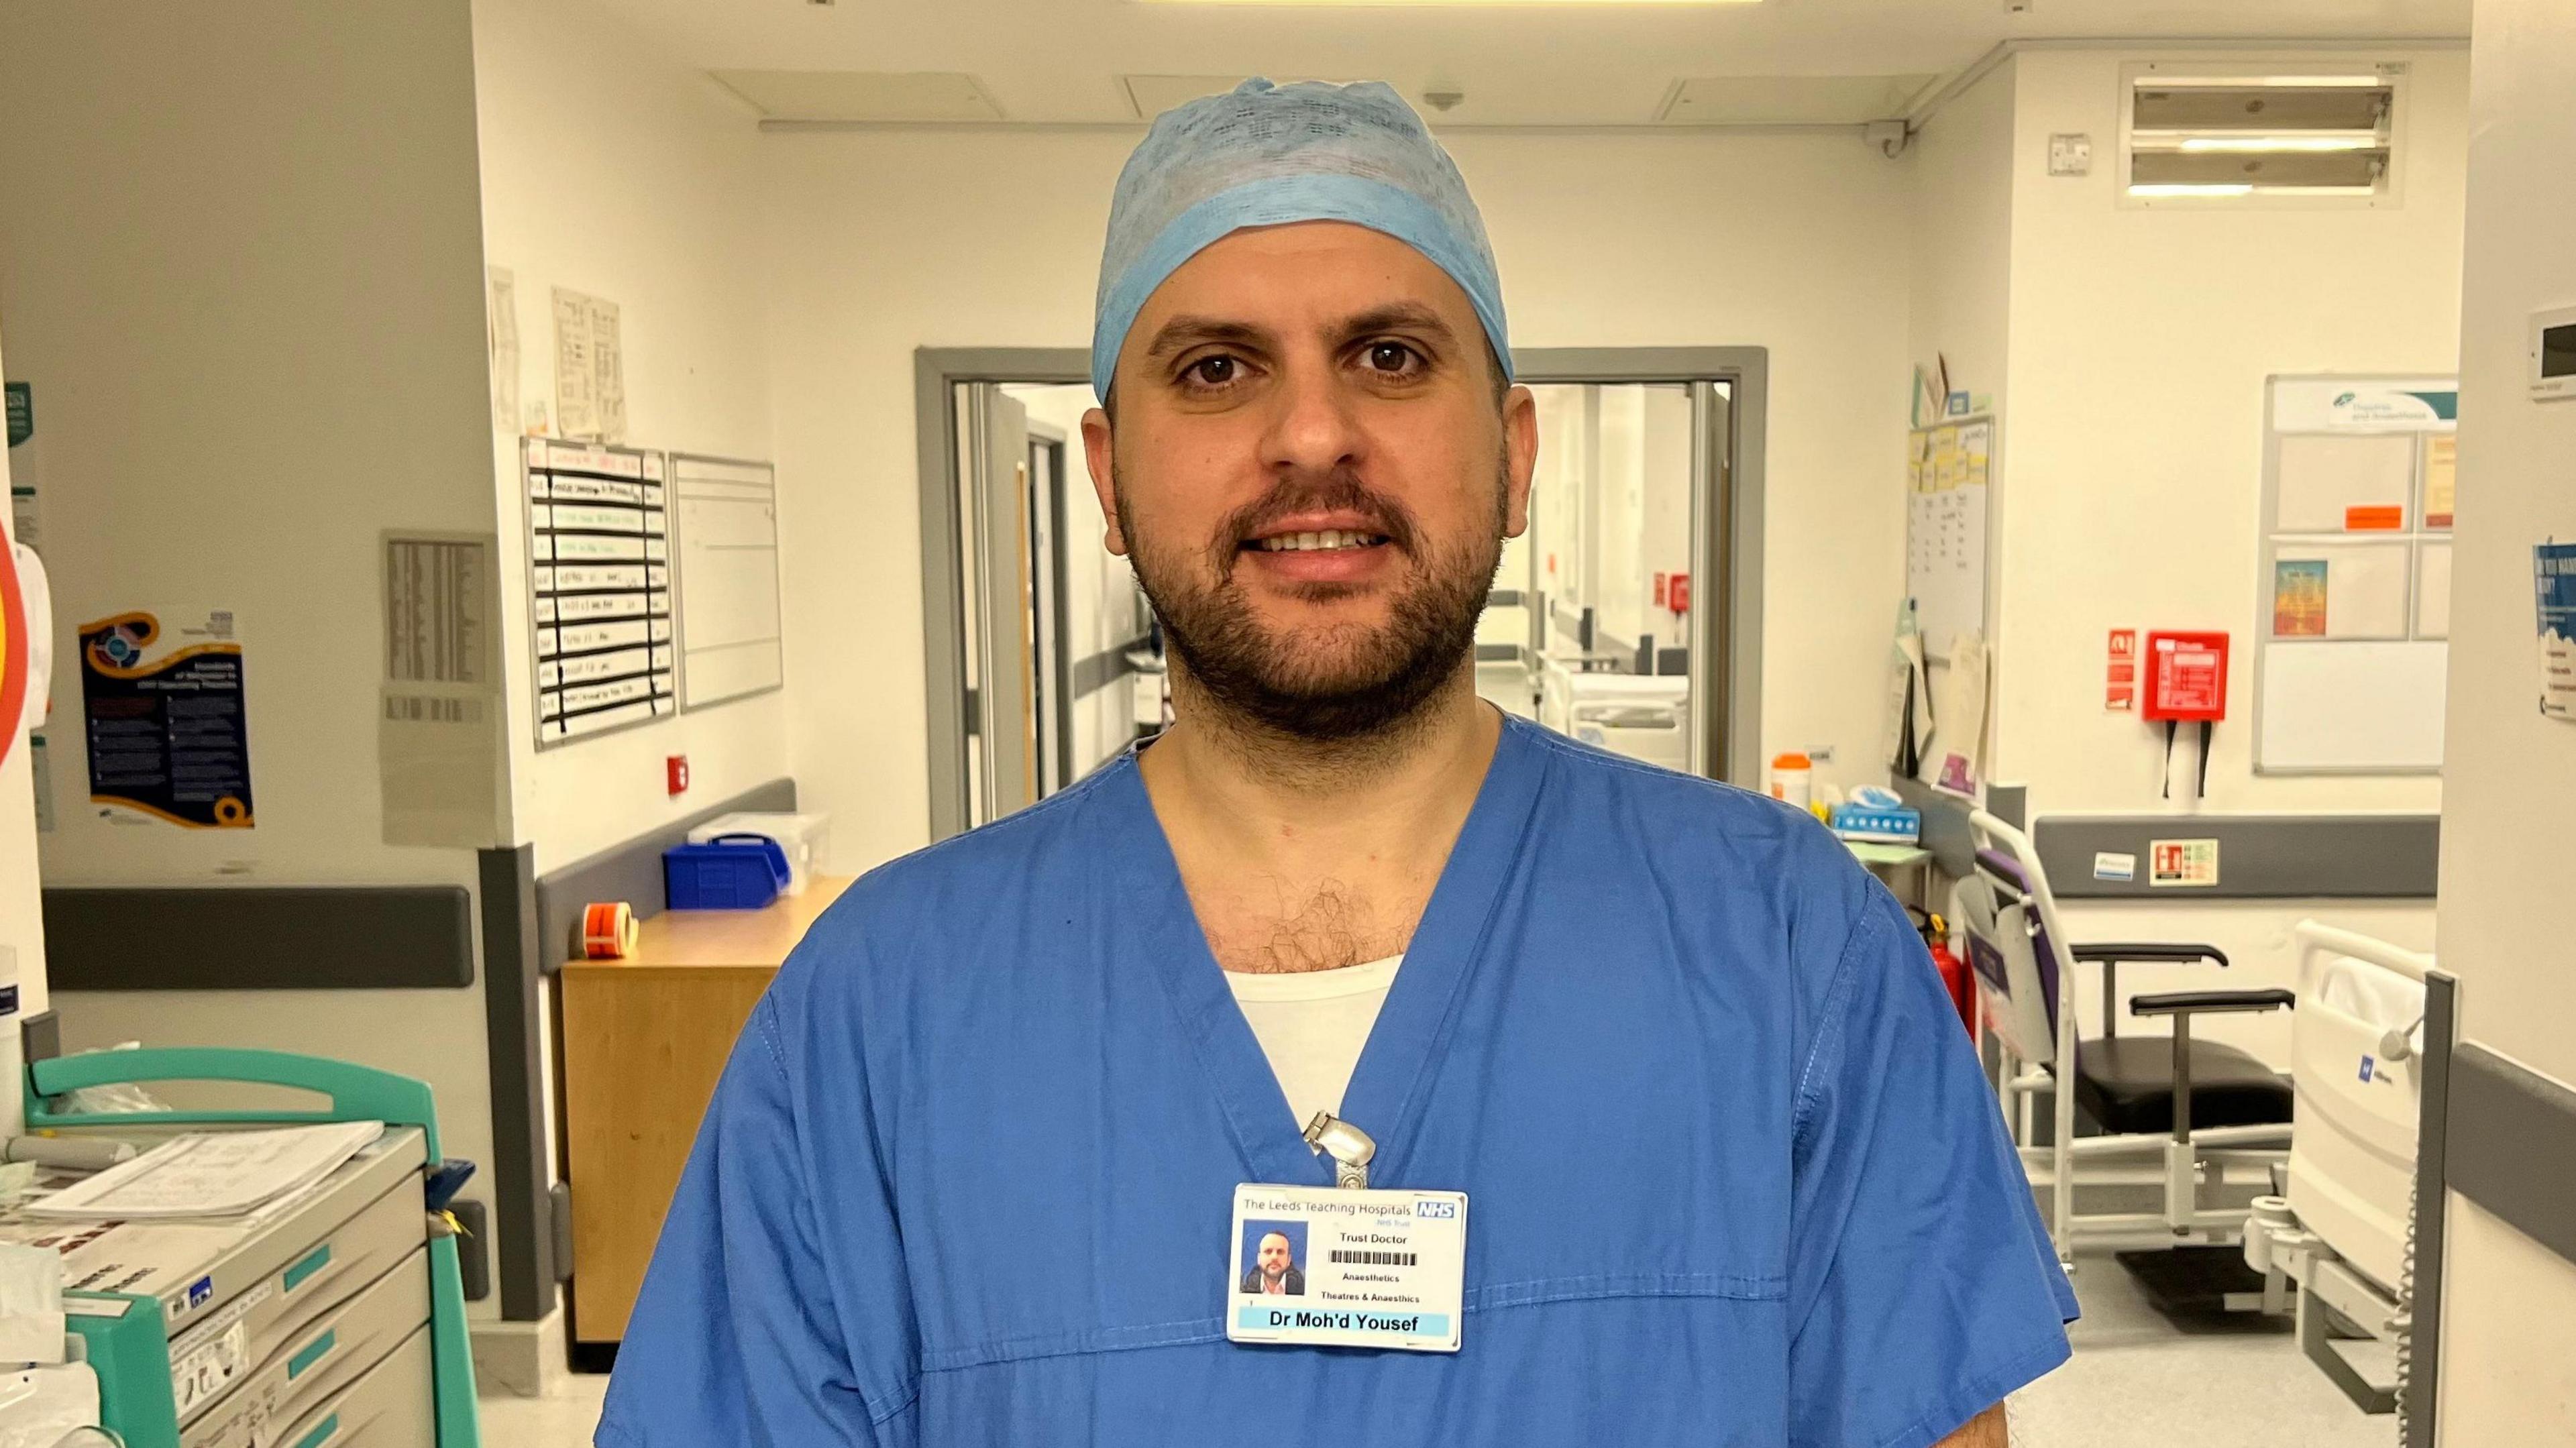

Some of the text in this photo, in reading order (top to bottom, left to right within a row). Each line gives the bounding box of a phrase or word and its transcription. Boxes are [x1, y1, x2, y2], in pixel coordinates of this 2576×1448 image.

[1244, 1199, 1411, 1217] The Leeds Teaching Hospitals
[1418, 1202, 1454, 1217] NHS
[1377, 1219, 1392, 1227] NHS
[1340, 1232, 1407, 1244] Trust Doctor
[1343, 1273, 1399, 1282] Anaesthetics
[1321, 1291, 1420, 1303] Theatres & Anaesthics
[1270, 1311, 1419, 1331] Dr Moh'd Yousef
